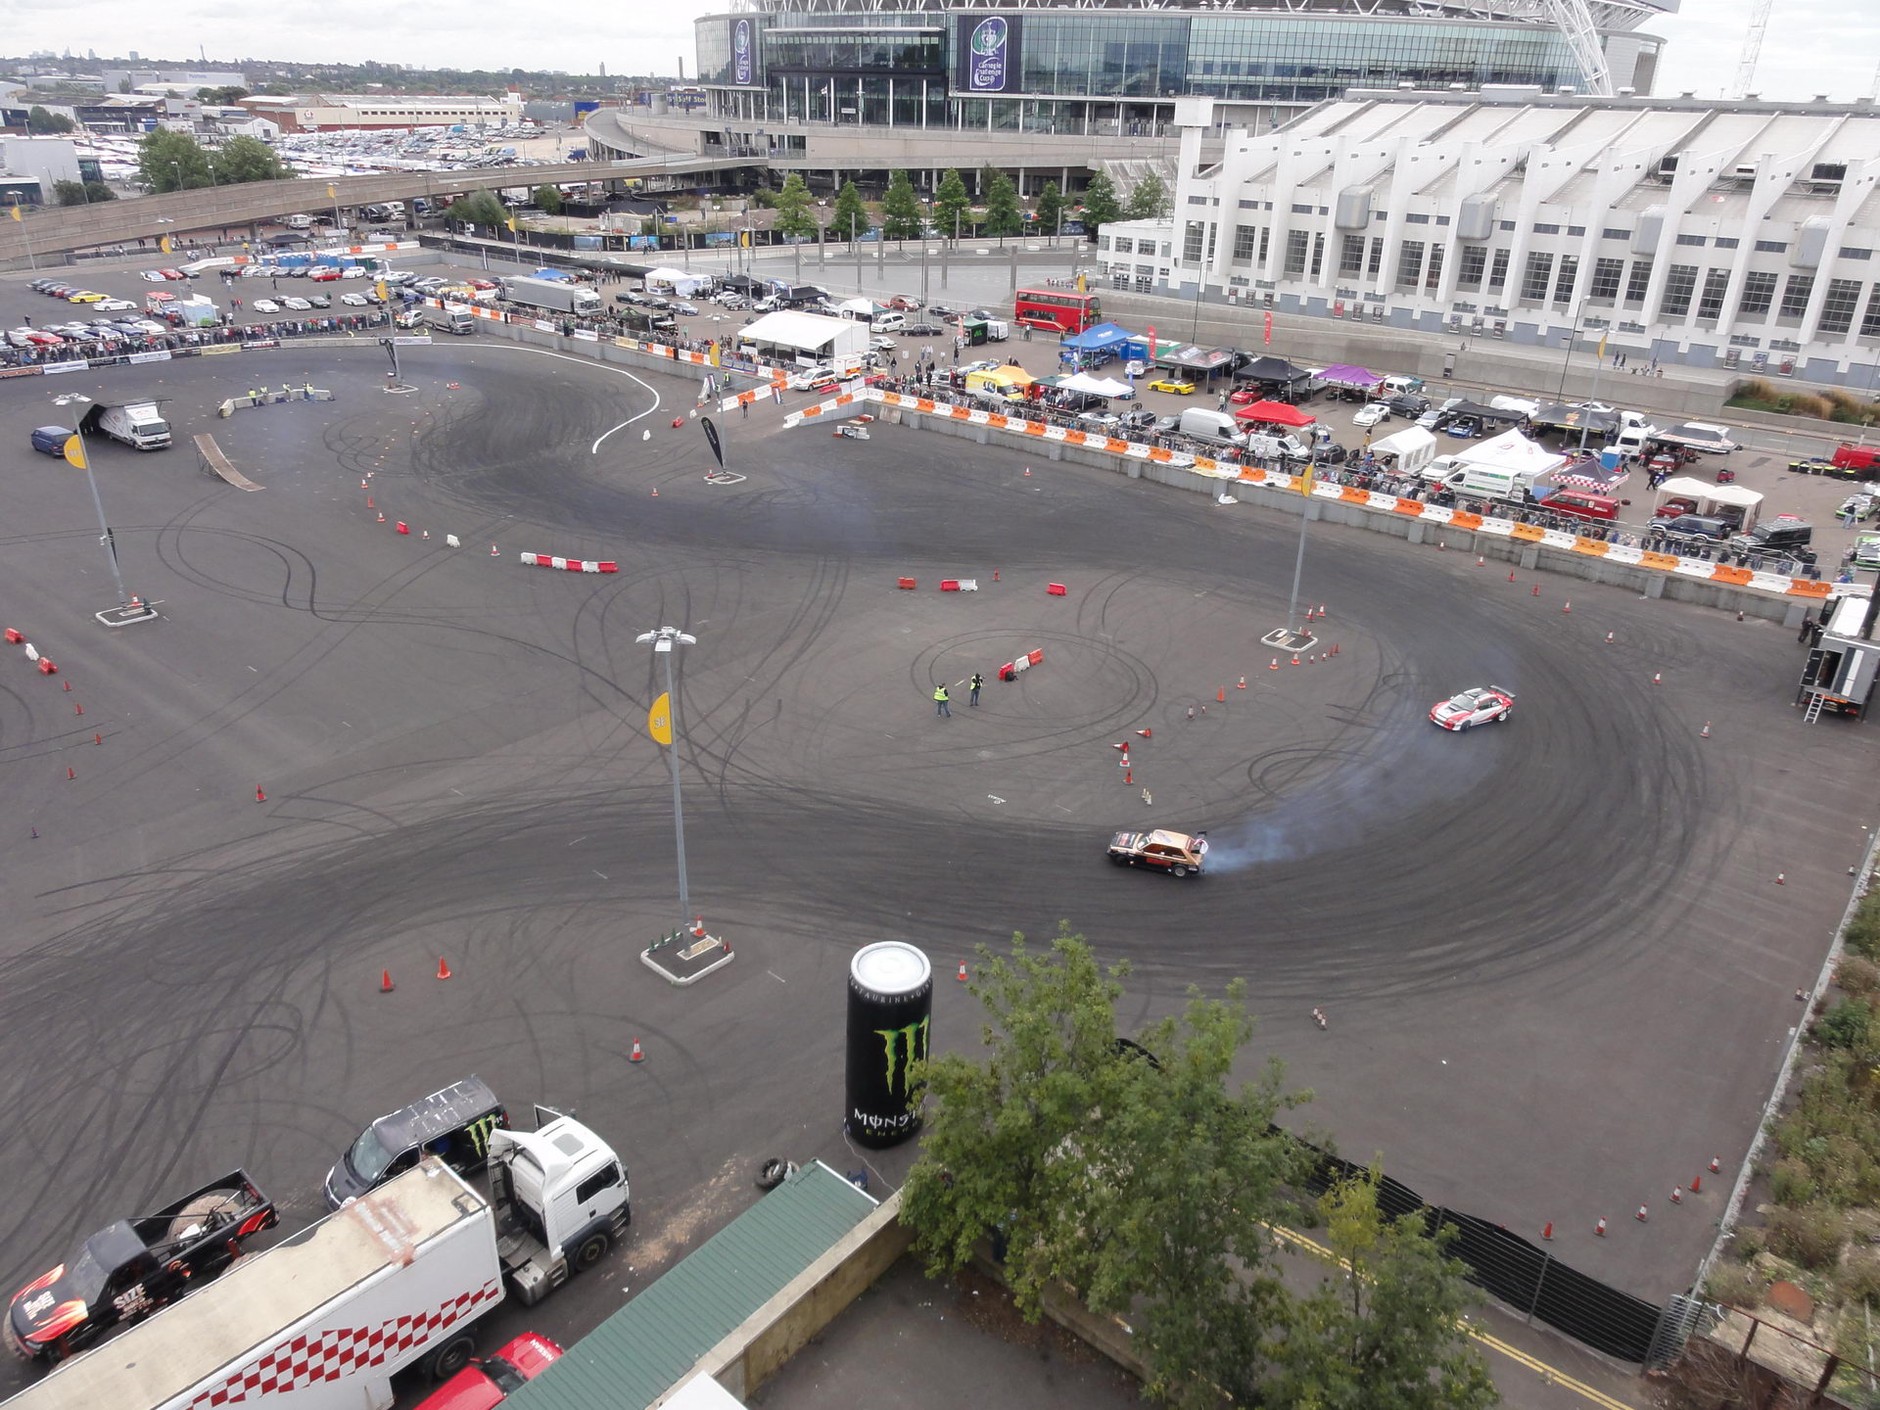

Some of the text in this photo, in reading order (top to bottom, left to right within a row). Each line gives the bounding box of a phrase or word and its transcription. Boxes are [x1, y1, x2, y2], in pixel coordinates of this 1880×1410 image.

[859, 988, 908, 1003] TAURINE
[113, 1283, 146, 1309] SIZE
[530, 1338, 555, 1361] NISSAN
